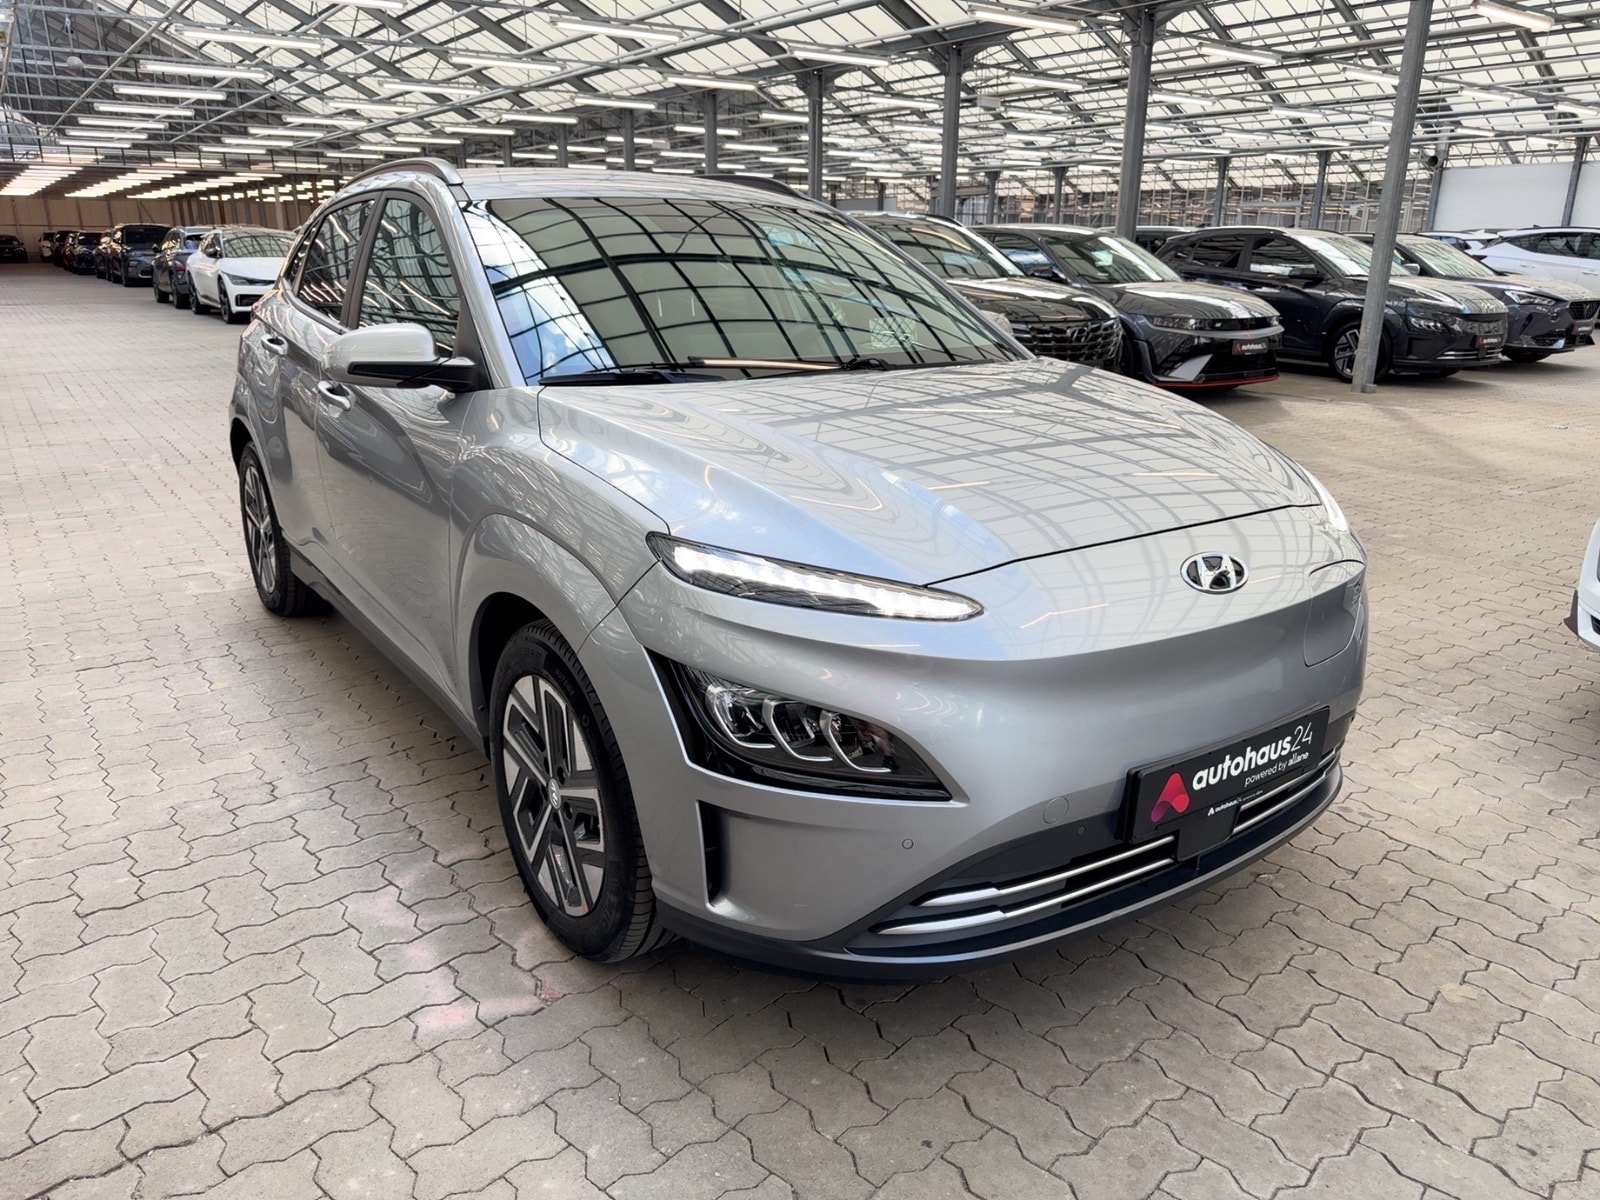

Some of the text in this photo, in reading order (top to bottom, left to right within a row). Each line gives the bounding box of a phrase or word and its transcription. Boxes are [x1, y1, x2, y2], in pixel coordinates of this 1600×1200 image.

[1192, 722, 1313, 791] autohaus24
[1244, 751, 1309, 788] powered by allane
